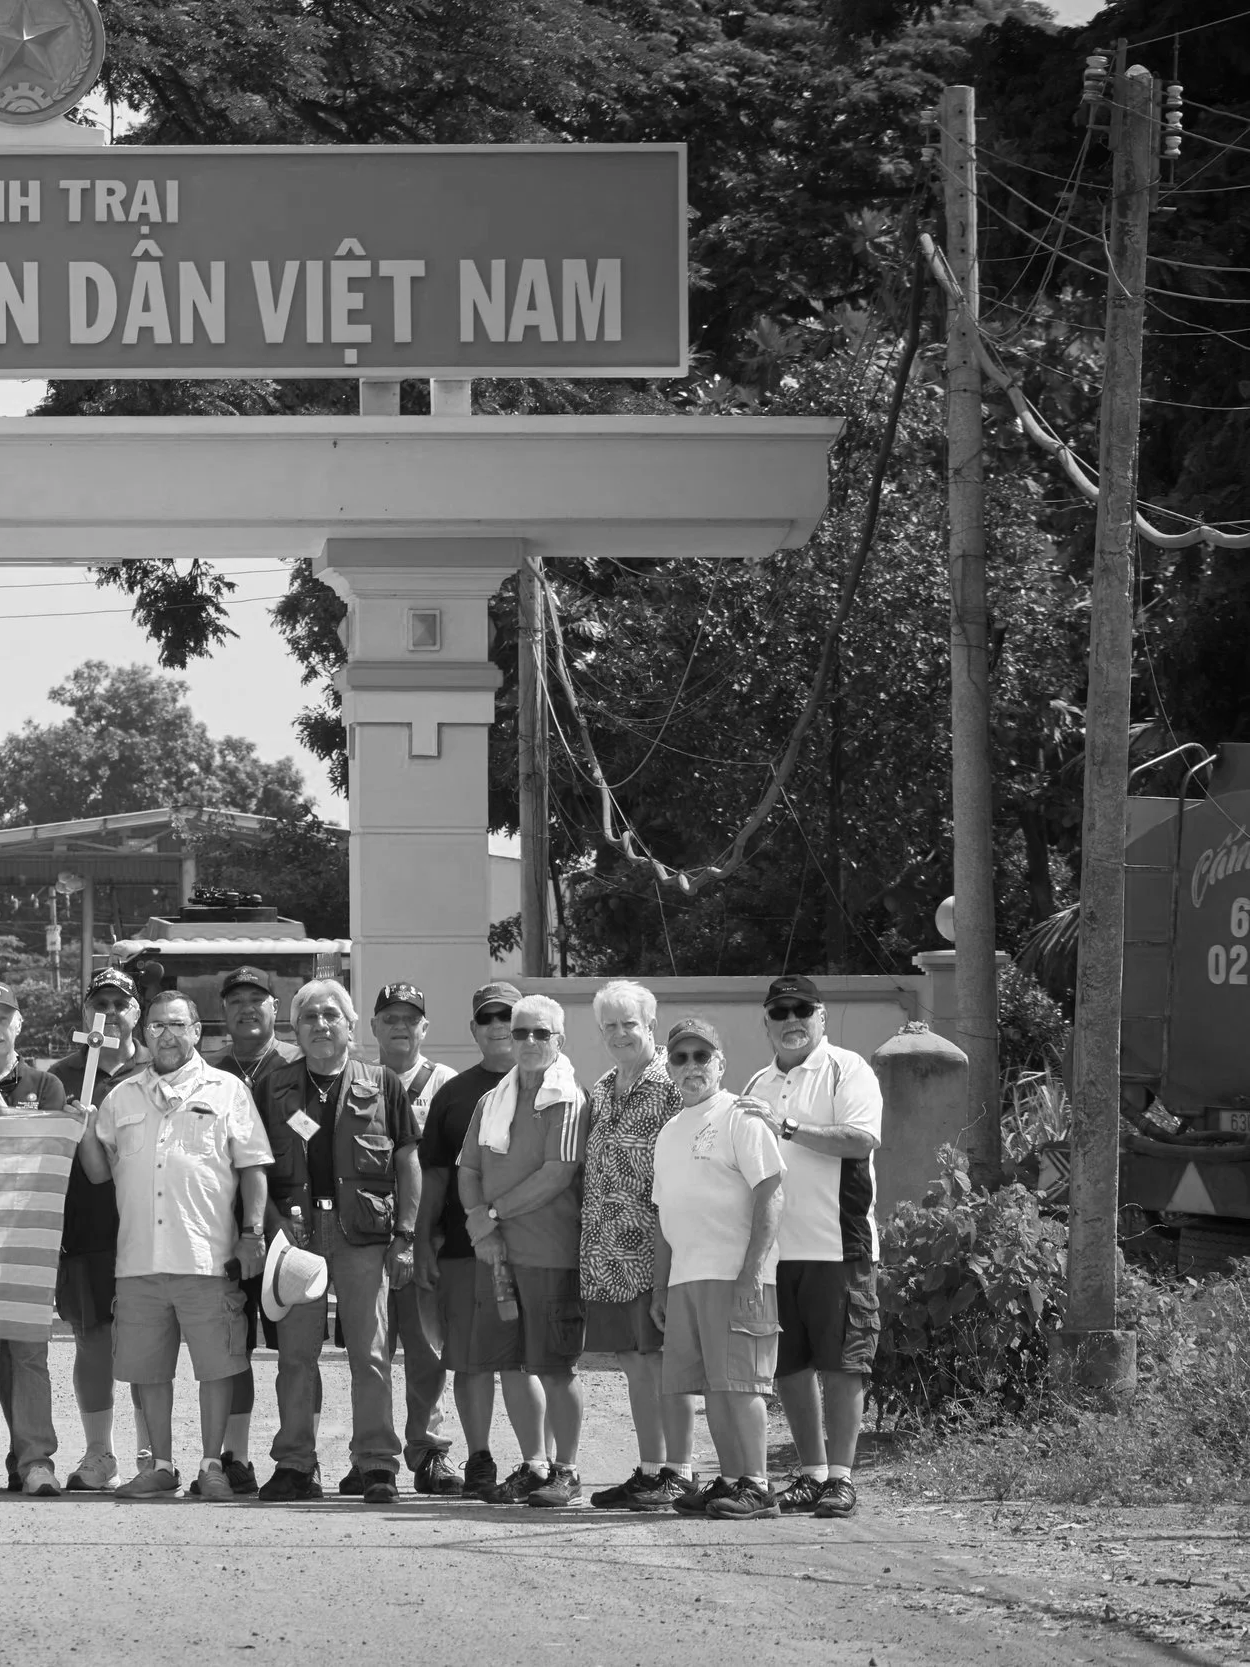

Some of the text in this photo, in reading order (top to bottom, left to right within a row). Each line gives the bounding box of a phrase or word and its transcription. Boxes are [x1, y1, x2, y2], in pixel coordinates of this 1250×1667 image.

[59, 180, 179, 234] TRẠI
[68, 239, 225, 344] DÂN
[251, 238, 425, 364] VIỆT
[459, 259, 621, 342] NAM
[1207, 944, 1248, 985] 02
